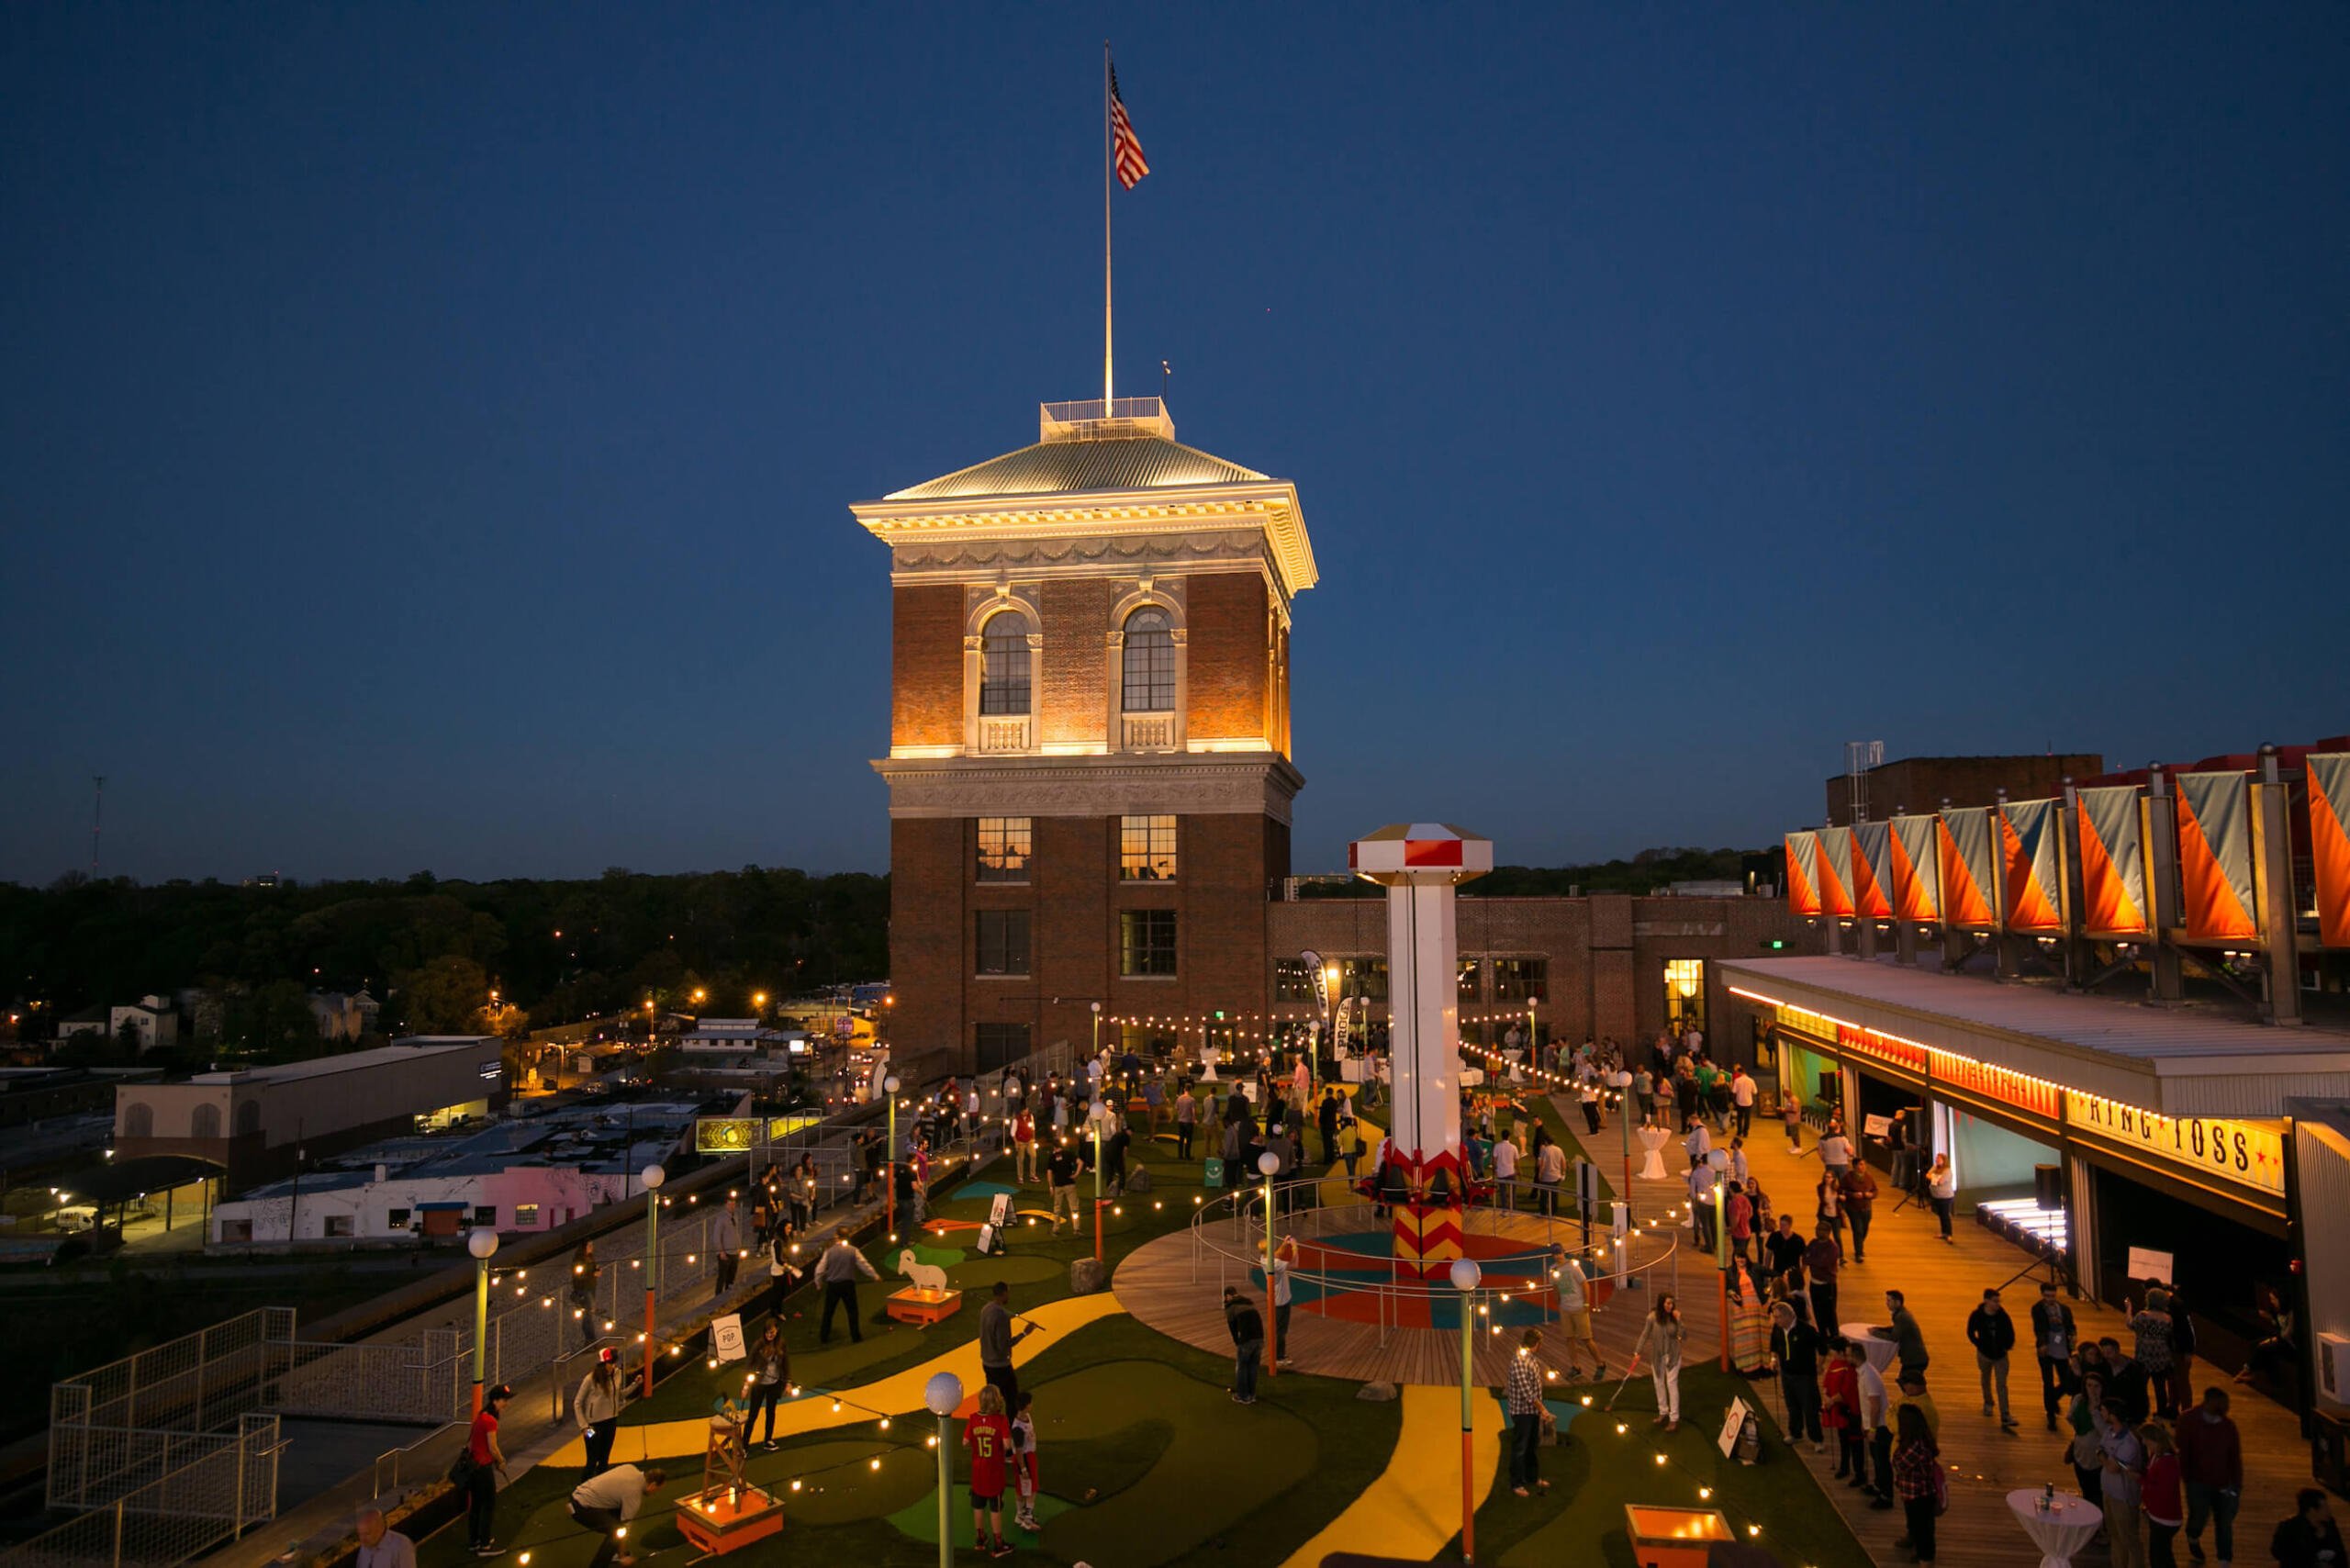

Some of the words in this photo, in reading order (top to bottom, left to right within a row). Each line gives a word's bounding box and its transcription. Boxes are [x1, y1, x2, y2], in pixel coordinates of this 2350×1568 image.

[2175, 1118, 2249, 1171] TOSS
[722, 1333, 735, 1343] POP
[977, 1437, 992, 1458] 15
